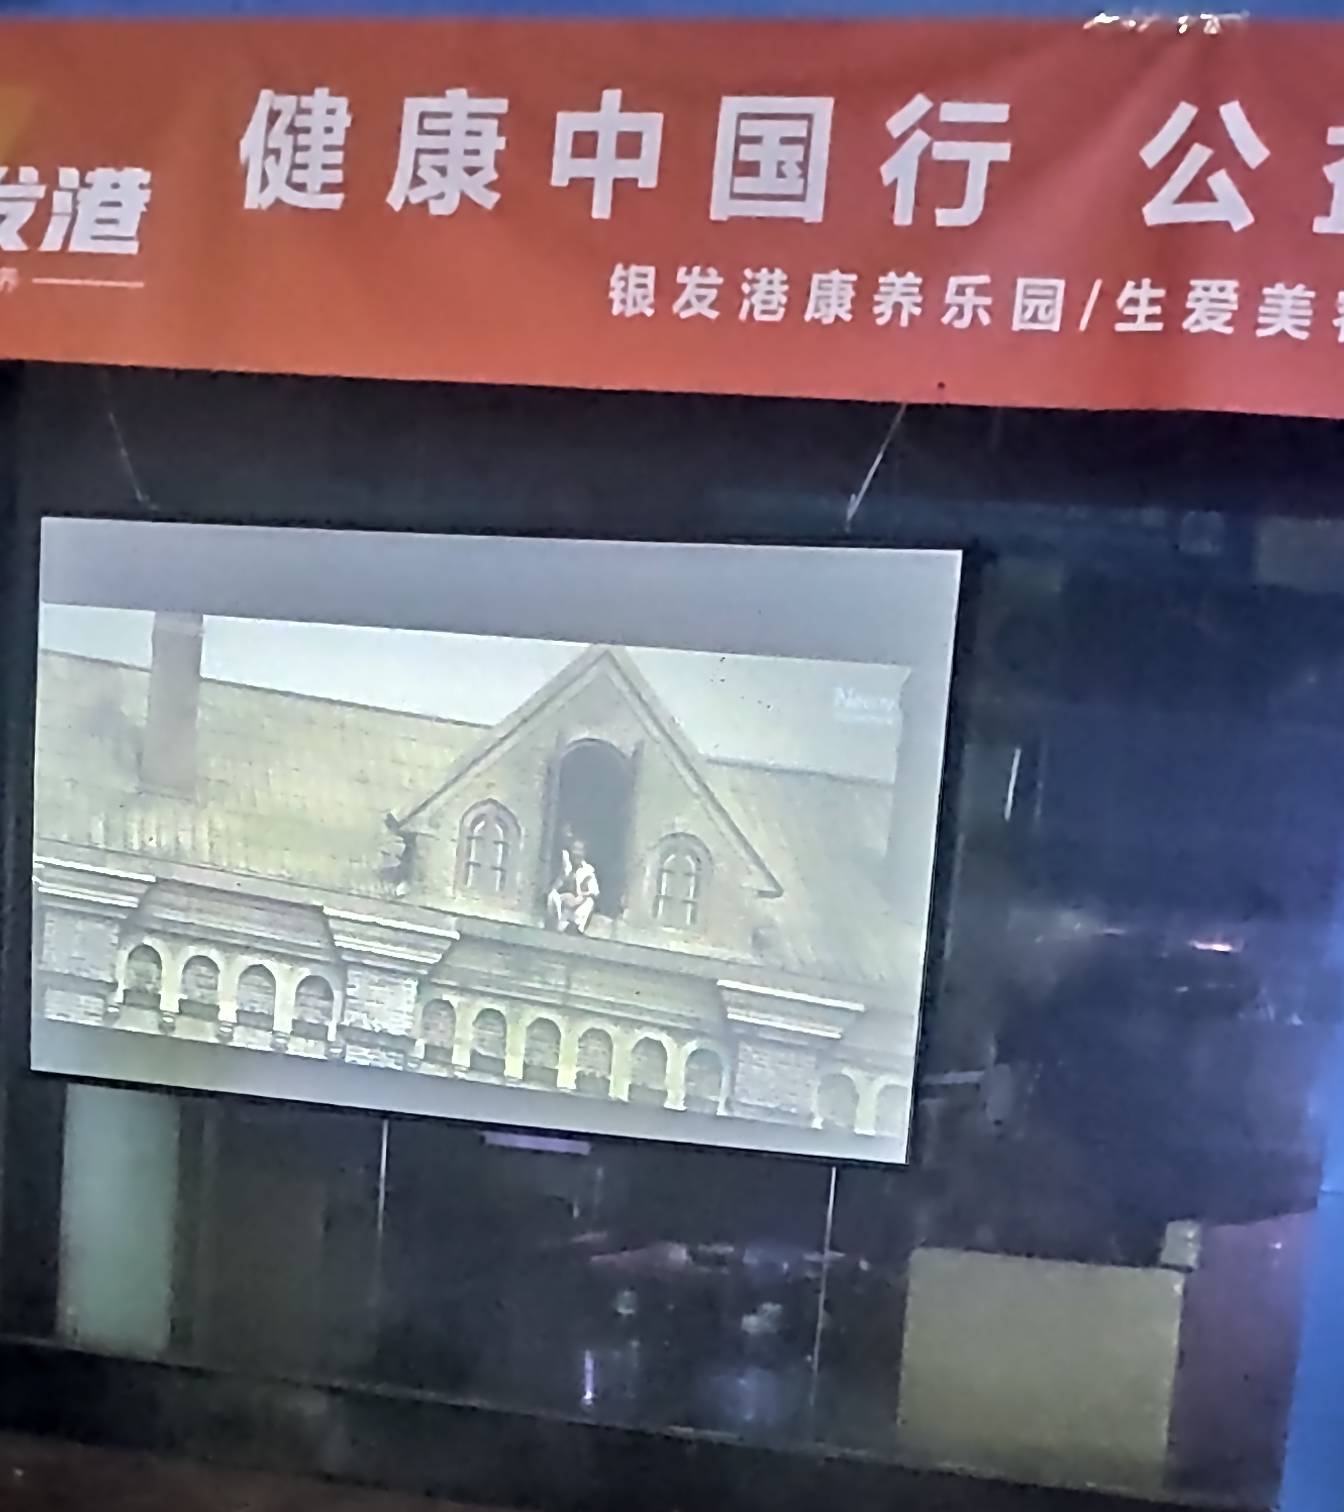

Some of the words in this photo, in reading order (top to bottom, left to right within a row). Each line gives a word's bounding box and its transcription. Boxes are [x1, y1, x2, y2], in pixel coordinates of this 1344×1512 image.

[239, 87, 1011, 229] 健康中国行
